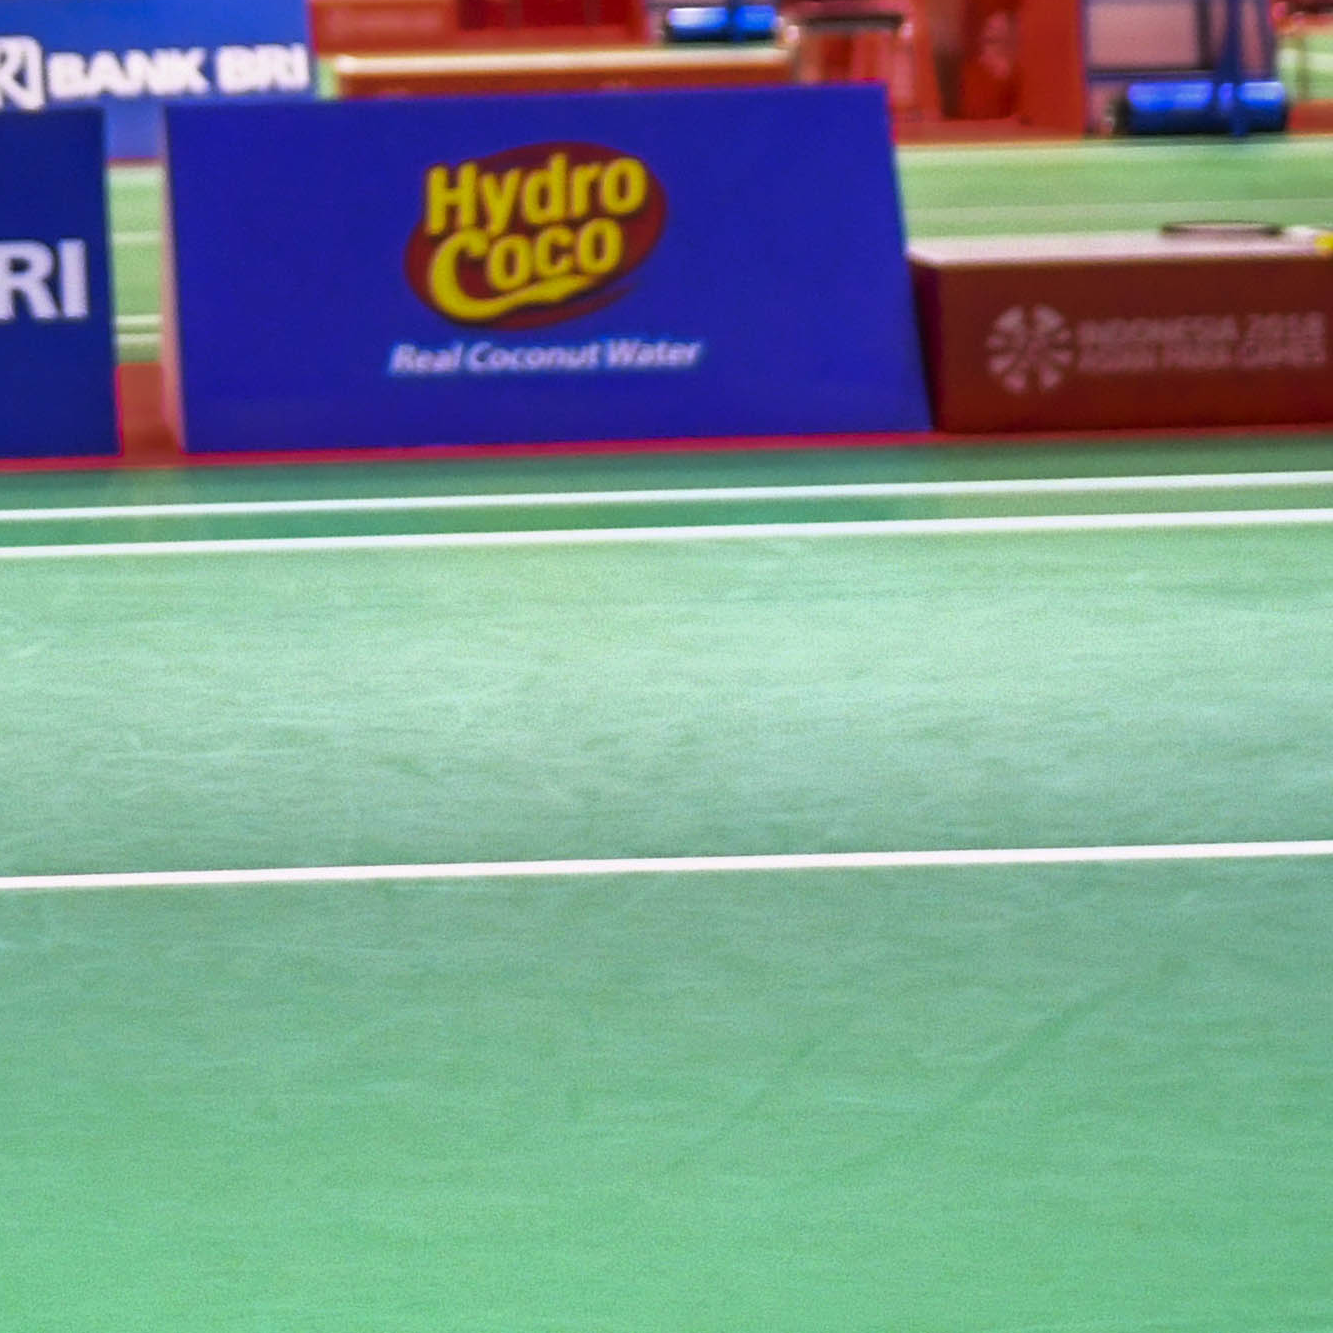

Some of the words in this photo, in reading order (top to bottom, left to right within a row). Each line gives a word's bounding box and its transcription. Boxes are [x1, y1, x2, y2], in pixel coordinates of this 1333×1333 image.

[46, 47, 209, 99] BANK
[214, 42, 311, 94] BRI
[424, 152, 646, 236] Hydro
[428, 217, 623, 321] Coco
[389, 342, 463, 374] Real
[466, 341, 601, 373] Coconut
[604, 338, 700, 369] Water
